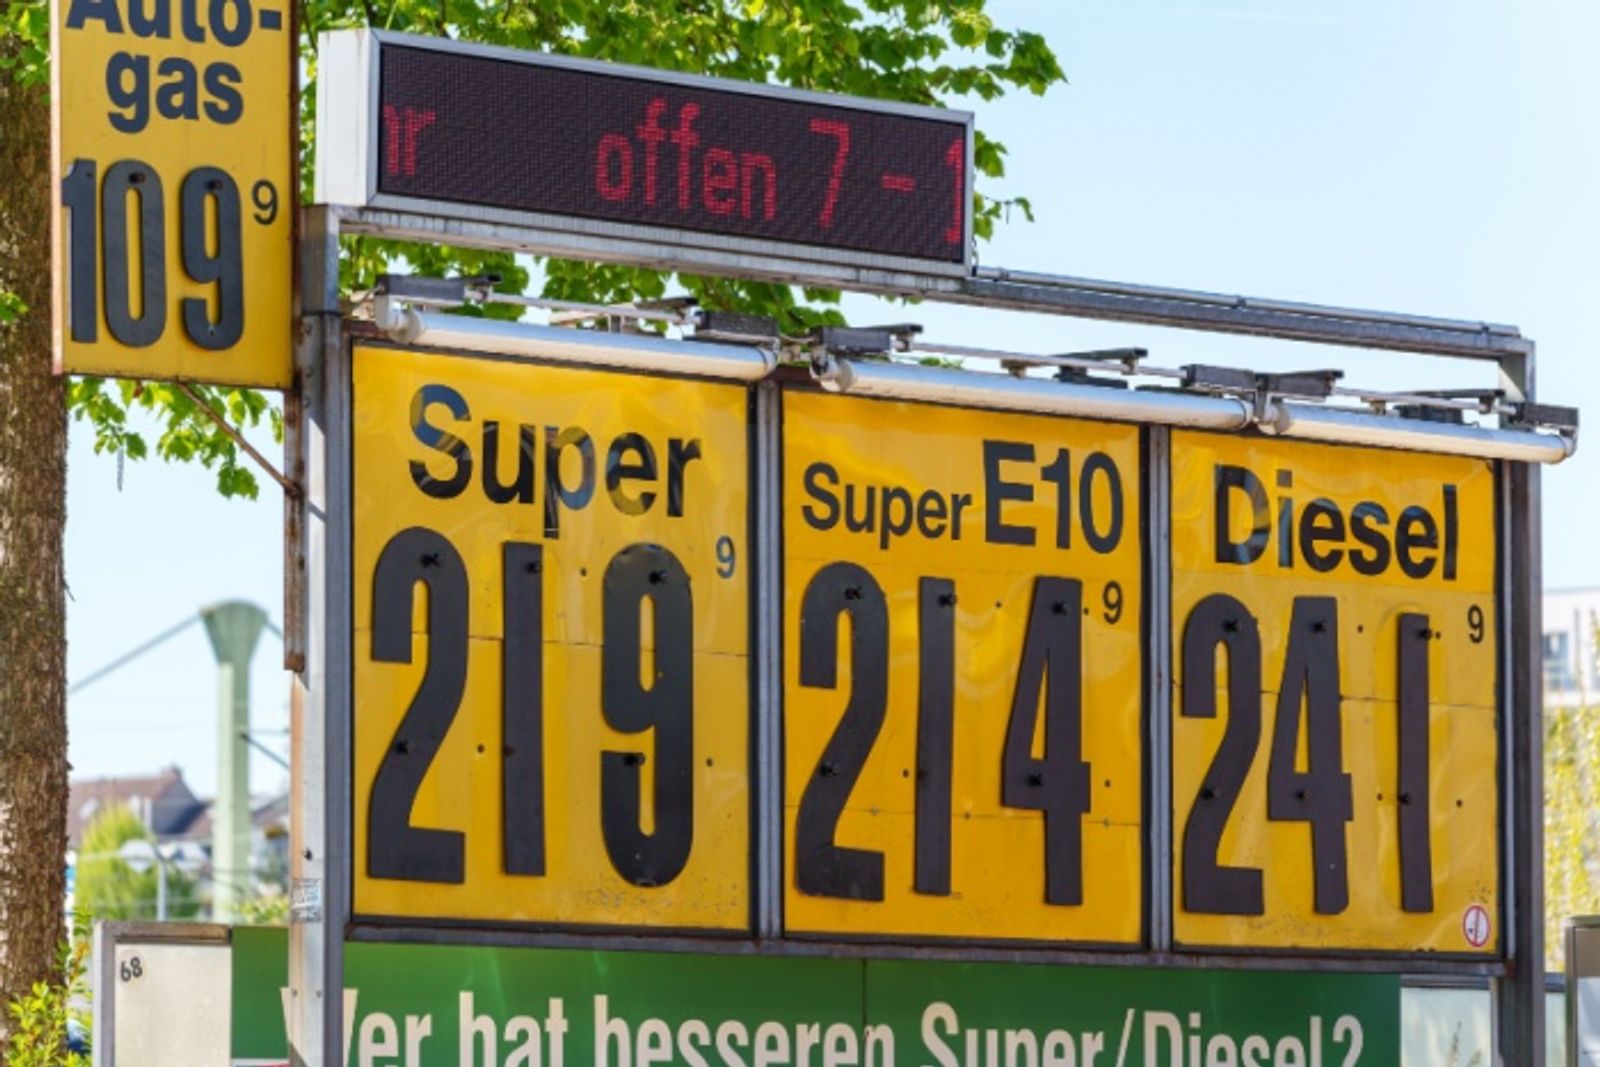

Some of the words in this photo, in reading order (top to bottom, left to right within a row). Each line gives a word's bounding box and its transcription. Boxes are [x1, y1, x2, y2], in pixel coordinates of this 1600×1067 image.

[106, 51, 244, 134] gas
[598, 98, 777, 220] offen
[810, 118, 849, 229] 7
[62, 158, 246, 350] 109
[252, 179, 279, 226] 9
[409, 384, 702, 539] Super
[802, 462, 972, 550] Super
[982, 439, 1124, 554] E10
[1214, 464, 1458, 580] Diesel
[367, 526, 694, 888] 219
[715, 536, 735, 579] 9
[794, 561, 1091, 906] 214
[1102, 582, 1123, 624] 9
[1181, 593, 1434, 915] 241
[1467, 605, 1485, 644] 9
[120, 956, 143, 982] 68
[281, 987, 432, 1067] er
[459, 991, 568, 1067] hat
[594, 995, 895, 1067] besseren
